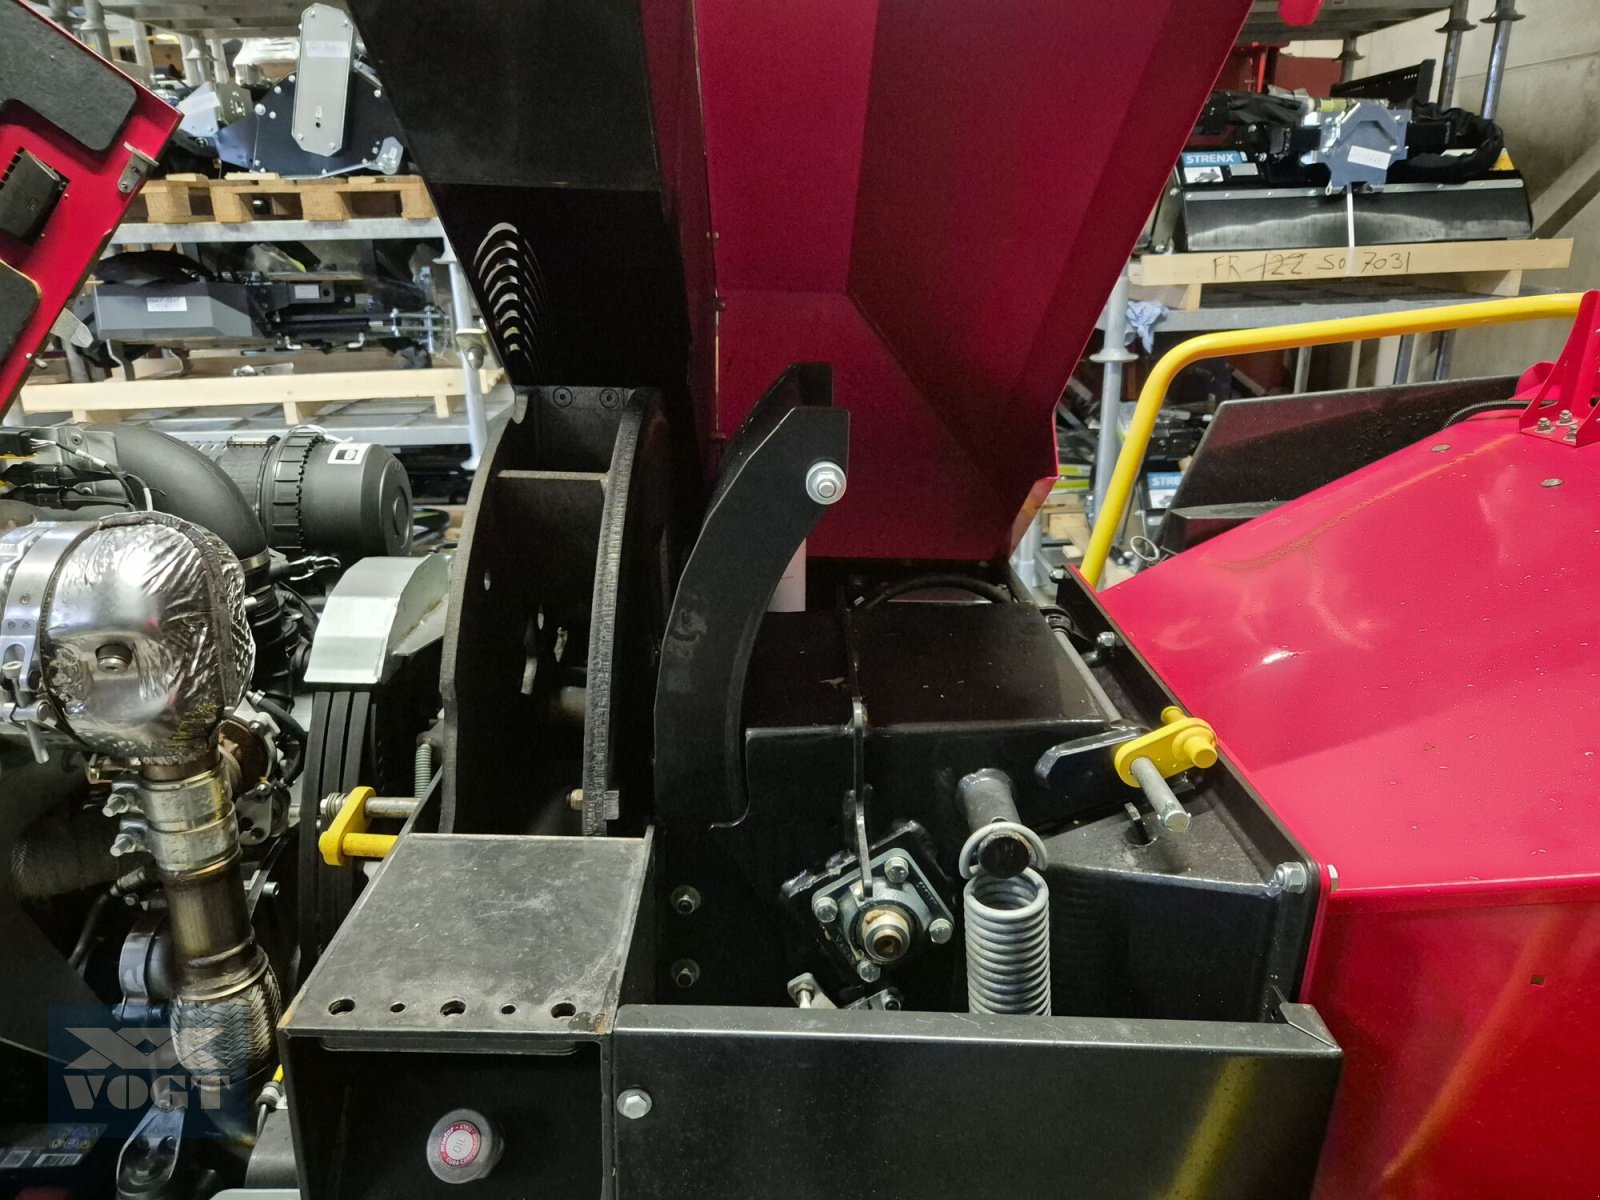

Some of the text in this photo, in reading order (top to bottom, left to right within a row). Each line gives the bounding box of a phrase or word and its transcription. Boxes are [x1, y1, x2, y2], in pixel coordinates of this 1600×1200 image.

[1186, 153, 1234, 164] STRENX
[1212, 255, 1241, 280] FR
[452, 1136, 467, 1153] OIL
